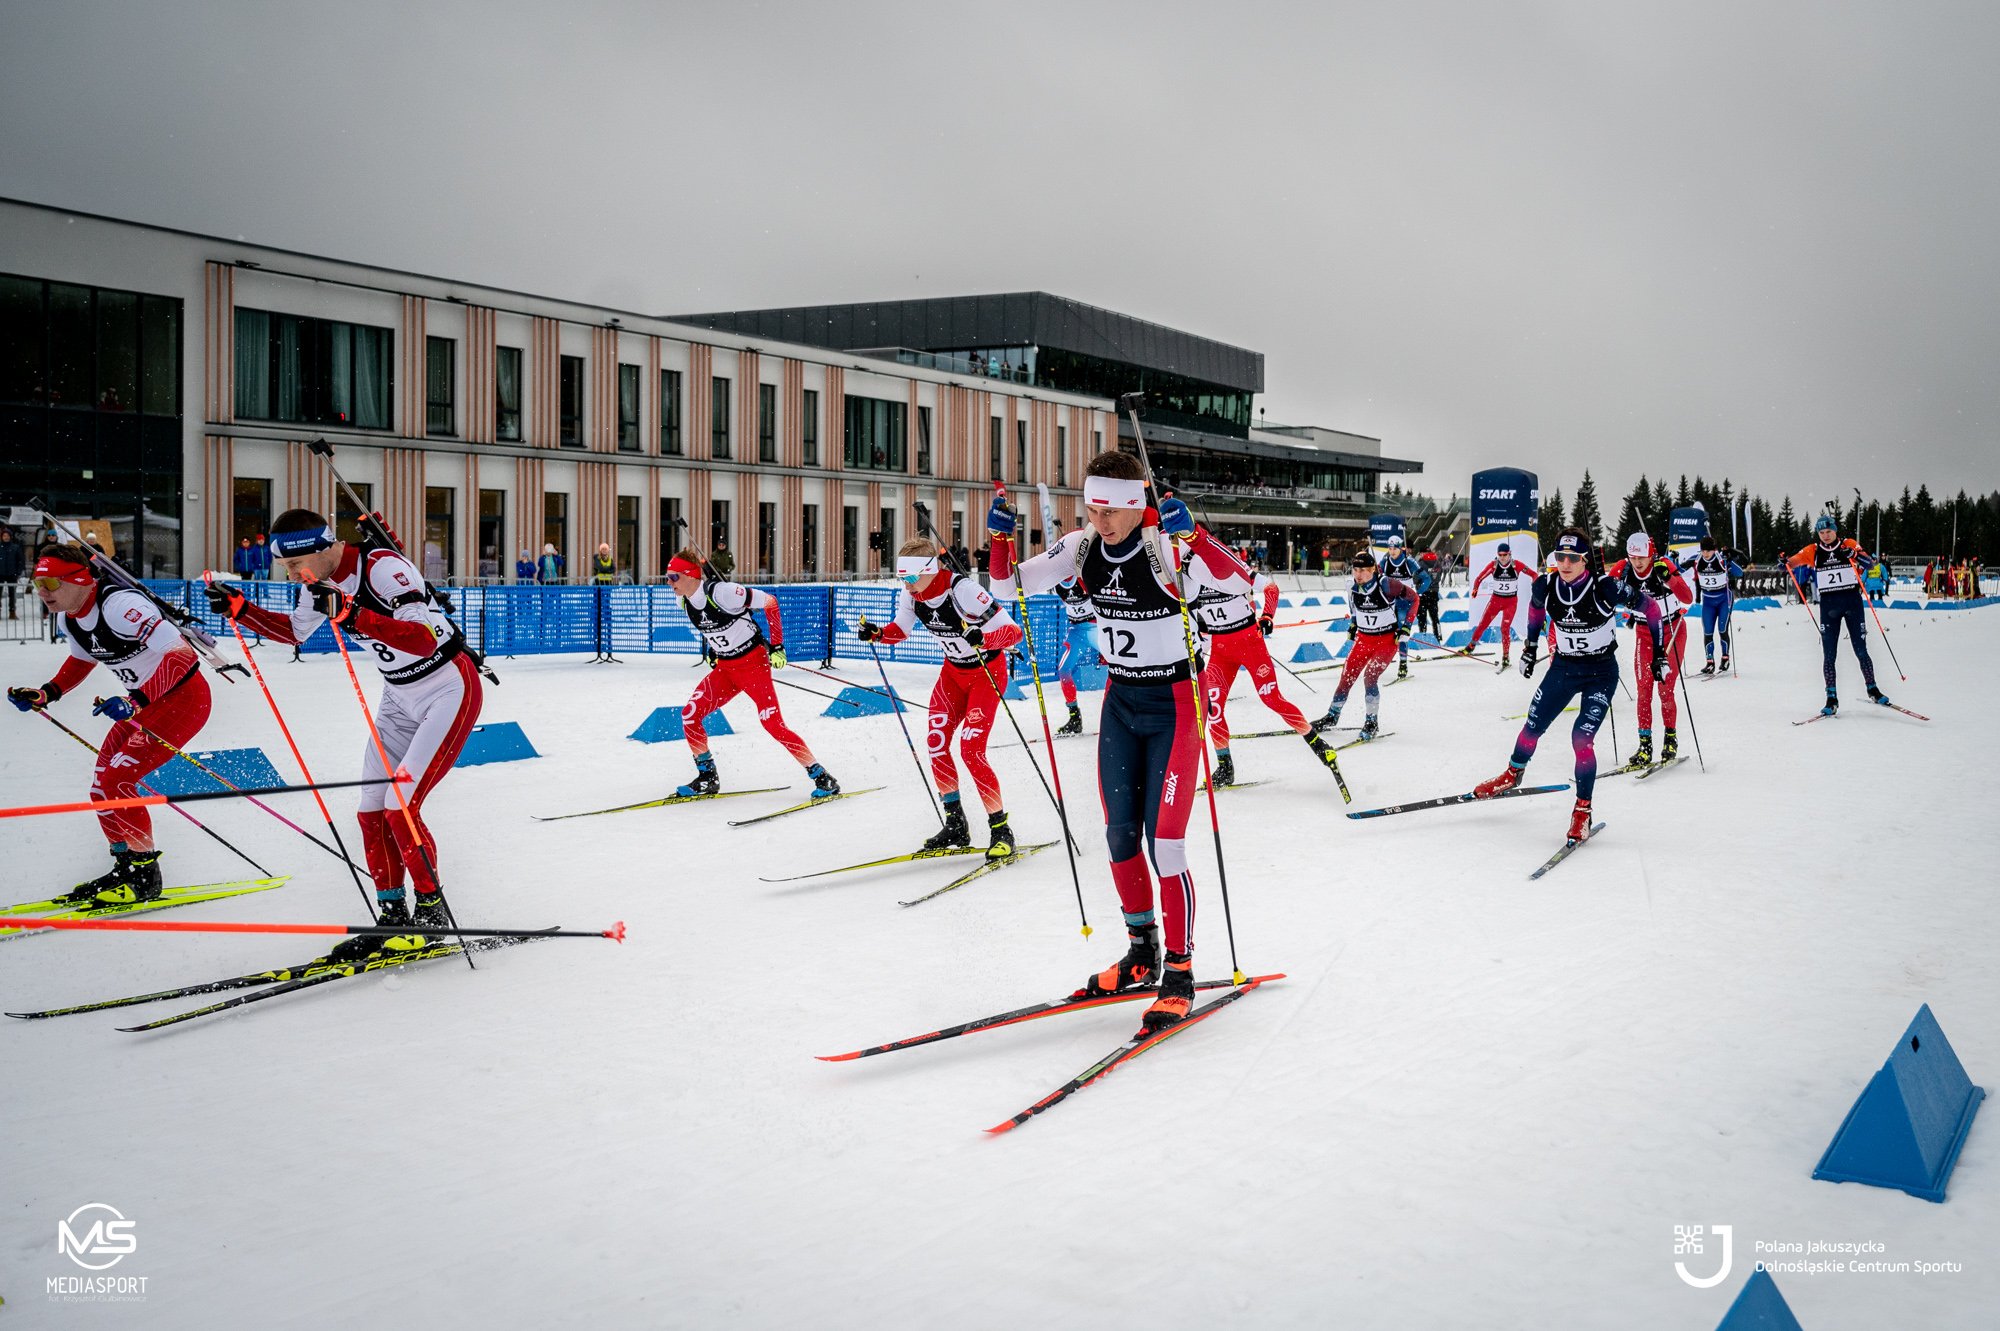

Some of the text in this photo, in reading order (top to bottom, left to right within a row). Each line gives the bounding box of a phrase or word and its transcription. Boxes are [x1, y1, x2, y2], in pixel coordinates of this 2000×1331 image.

[1478, 488, 1516, 500] START
[1828, 572, 1842, 584] 21
[1072, 606, 1086, 614] 16
[1102, 608, 1110, 616] W
[1112, 607, 1170, 618] IGRZYSKA
[1207, 607, 1227, 622] 14
[1364, 616, 1378, 625] 17
[434, 625, 444, 637] 8
[710, 636, 729, 648] 13
[941, 640, 962, 654] 11
[1102, 626, 1138, 658] 12
[1565, 637, 1589, 650] 15
[372, 642, 396, 662] 8
[912, 849, 971, 860] FISCHER
[87, 905, 133, 917] FISCHER
[364, 945, 462, 972] FISCHER
